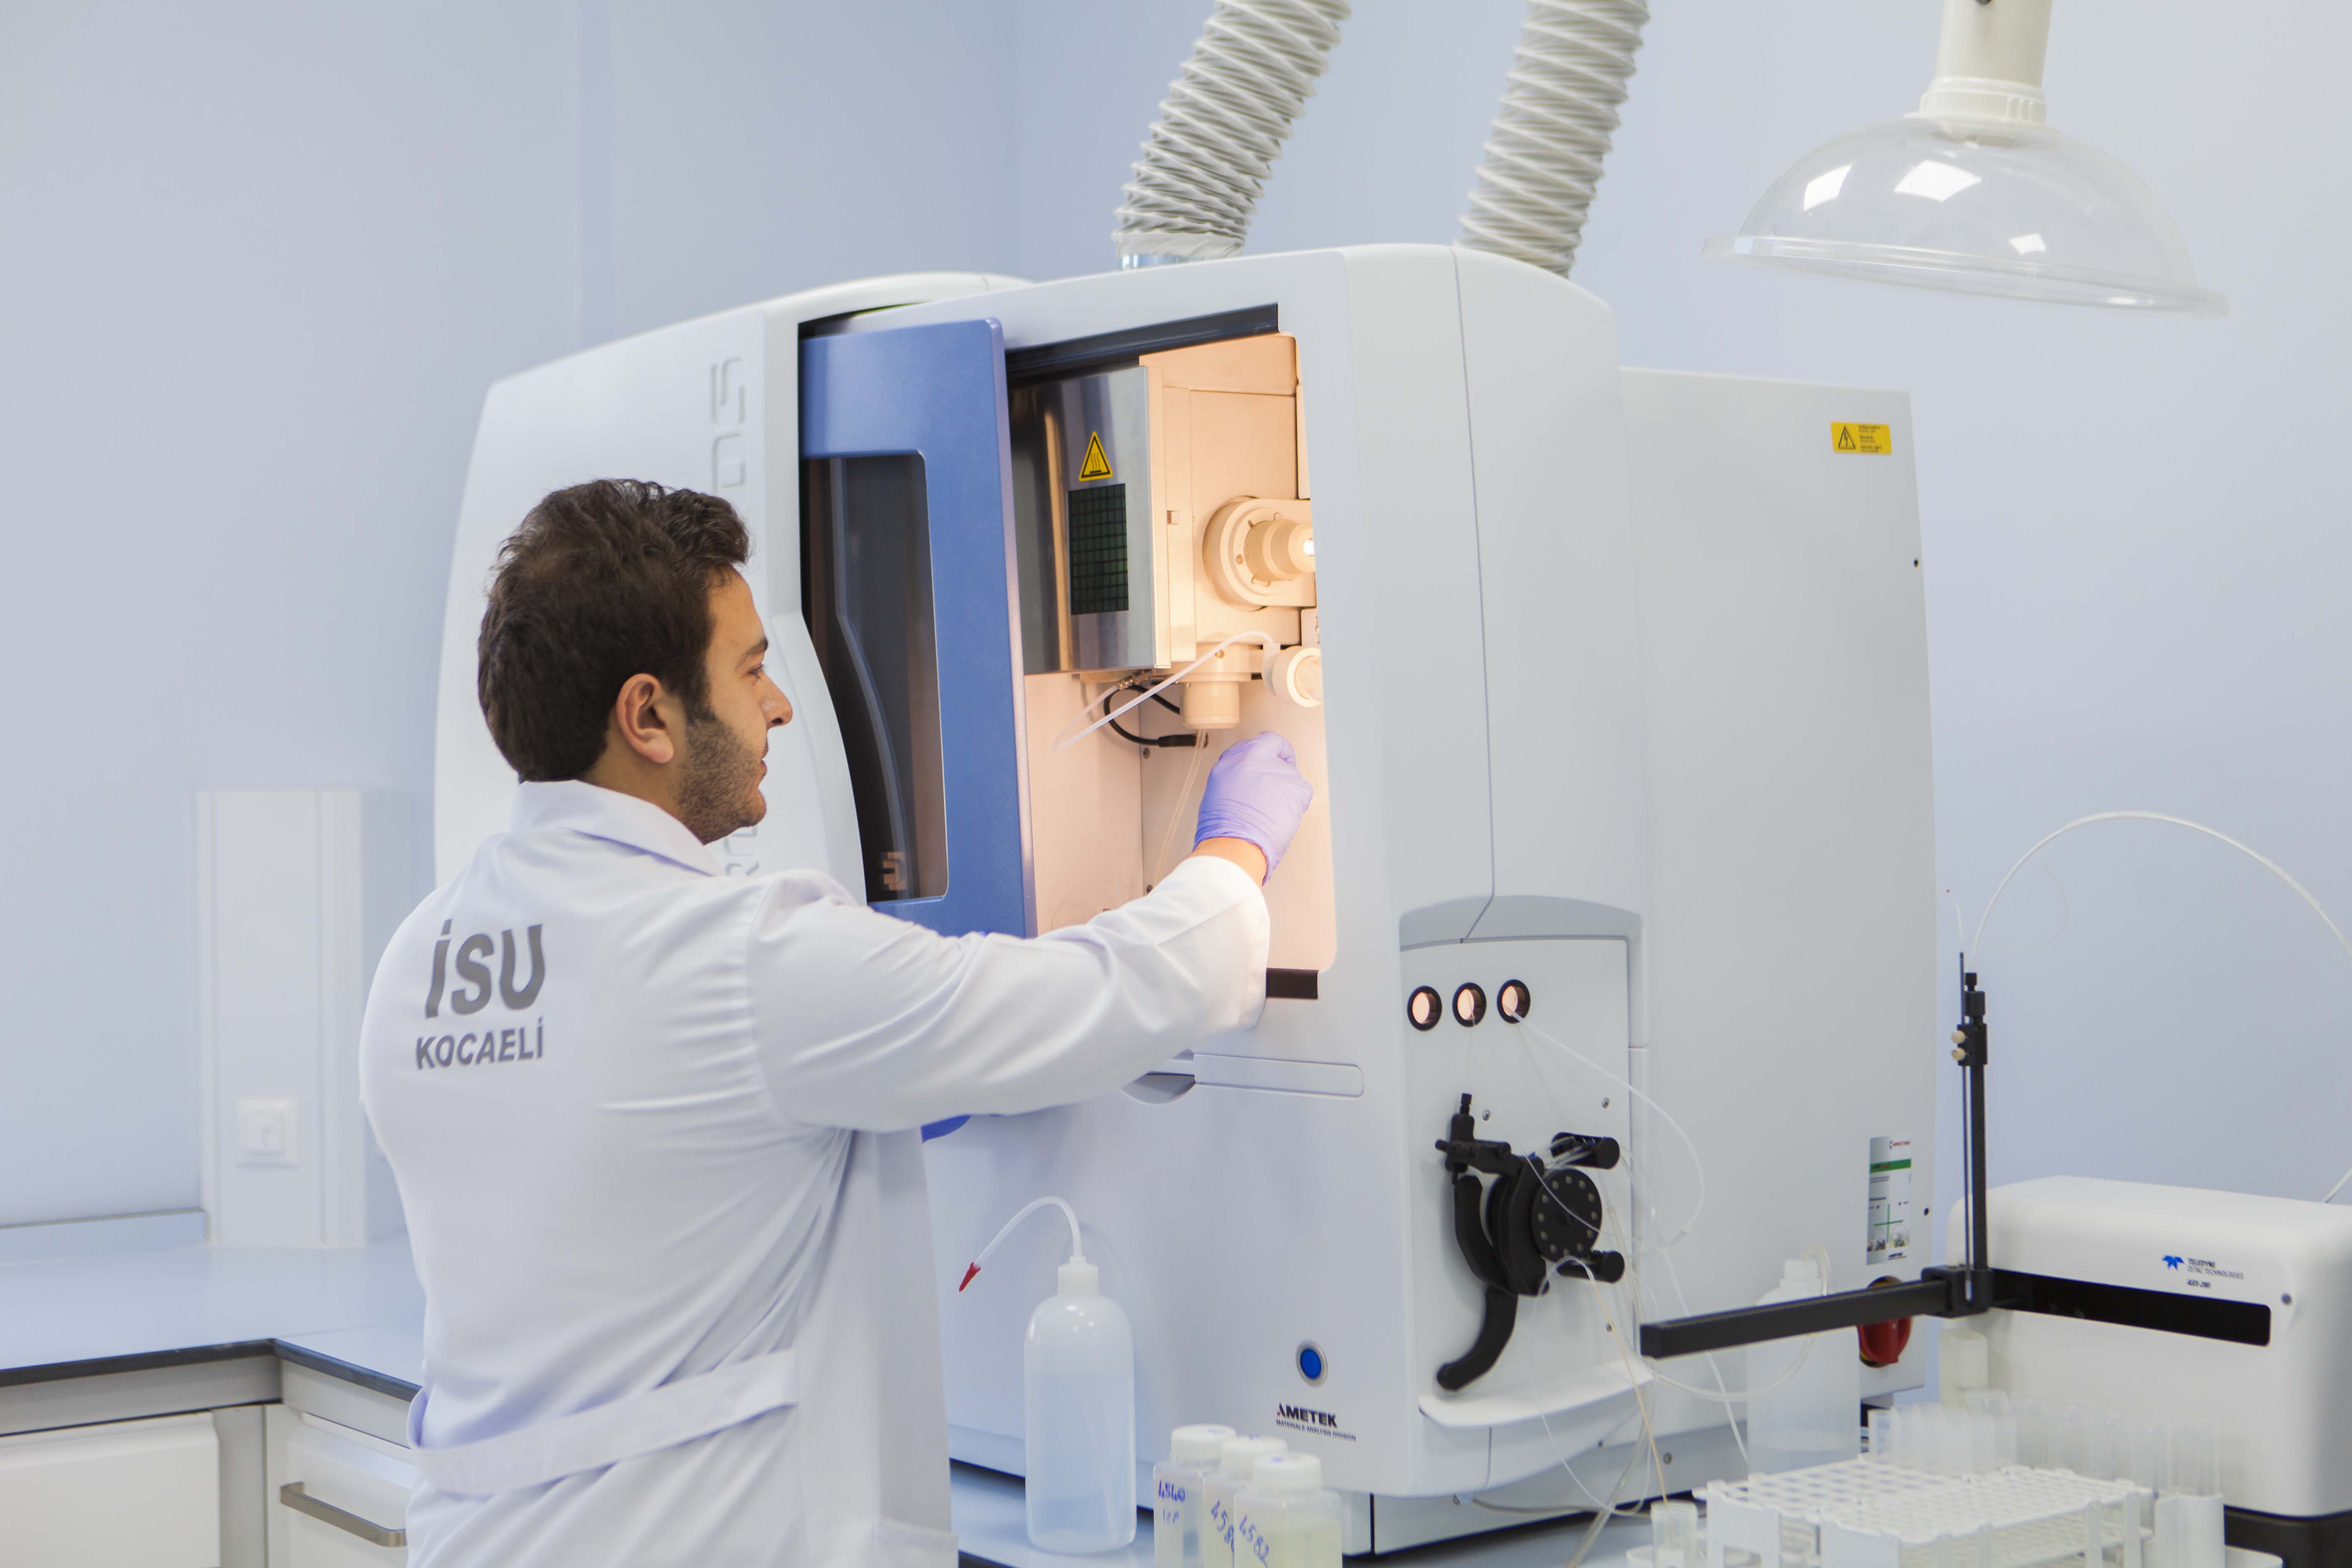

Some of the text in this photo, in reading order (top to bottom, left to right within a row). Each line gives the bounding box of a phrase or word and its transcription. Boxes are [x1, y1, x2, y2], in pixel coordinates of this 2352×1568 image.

[425, 918, 545, 1019] İSU
[416, 1016, 544, 1070] KOCAELİ
[1276, 1419, 1357, 1442] MATERIALS ANALYSIS DIVISION
[1277, 1402, 1338, 1428] AMETEK
